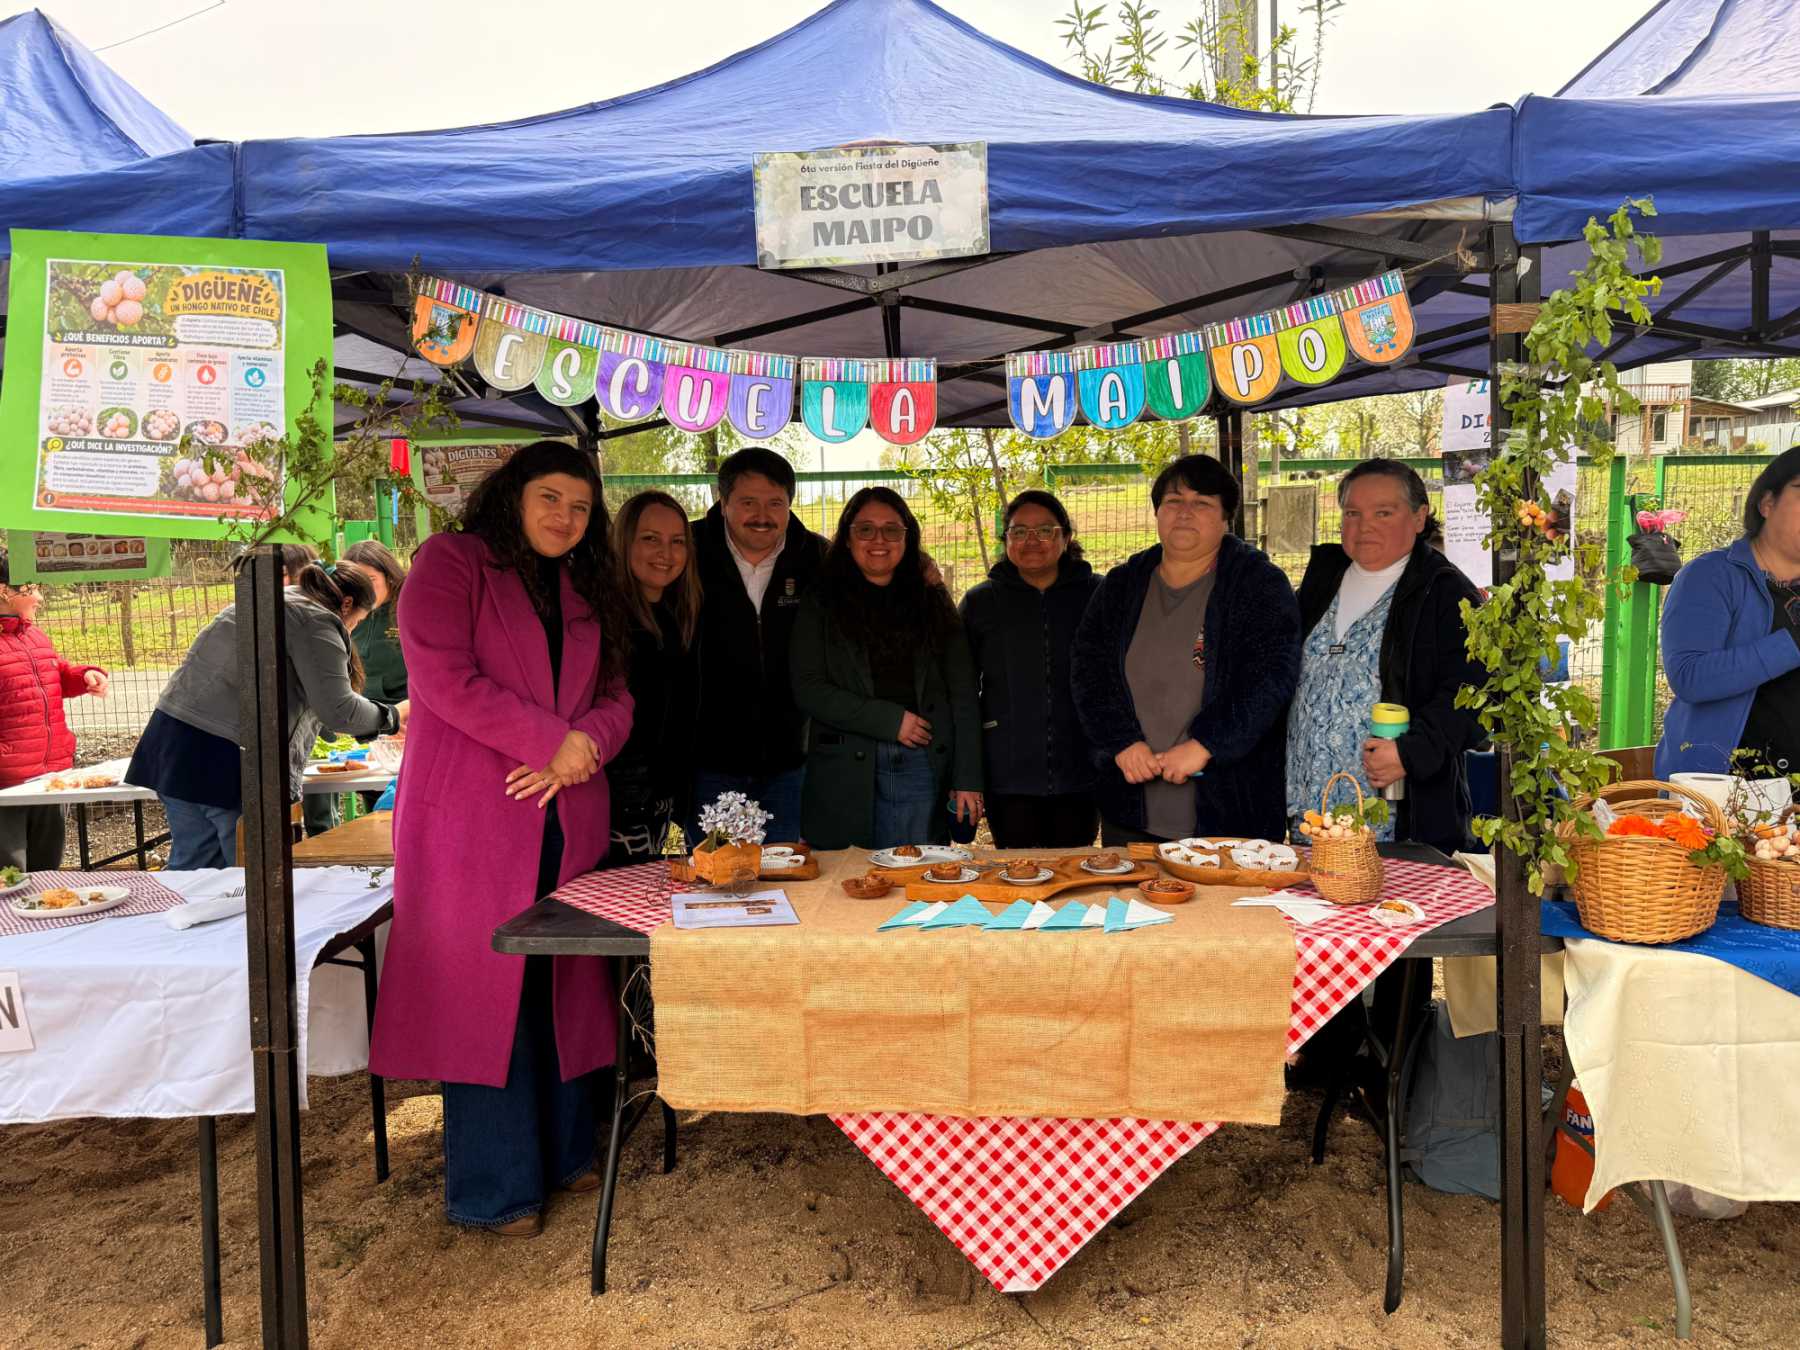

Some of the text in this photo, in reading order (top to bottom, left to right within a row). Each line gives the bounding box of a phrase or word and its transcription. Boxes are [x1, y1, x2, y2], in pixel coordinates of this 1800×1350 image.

[801, 158, 939, 173] 6ta versión Fiesta del Digüeñe
[800, 179, 943, 211] ESCUELA
[813, 215, 933, 247] MAIPO
[182, 275, 264, 305] DIGÜEÑE
[182, 303, 208, 311] HONGO
[211, 302, 238, 312] NATIVO
[240, 305, 251, 313] DE
[253, 306, 275, 316] CHILE
[63, 332, 167, 345] ¿QUÉ BENEFICIOS APORTA?
[494, 332, 915, 438] ESCUELA
[1020, 327, 1326, 431] MAIPO
[65, 440, 173, 454] ¿QUÉ DICE LA INVESTIGACIÓN?
[448, 446, 497, 461] DIGÜEÑES
